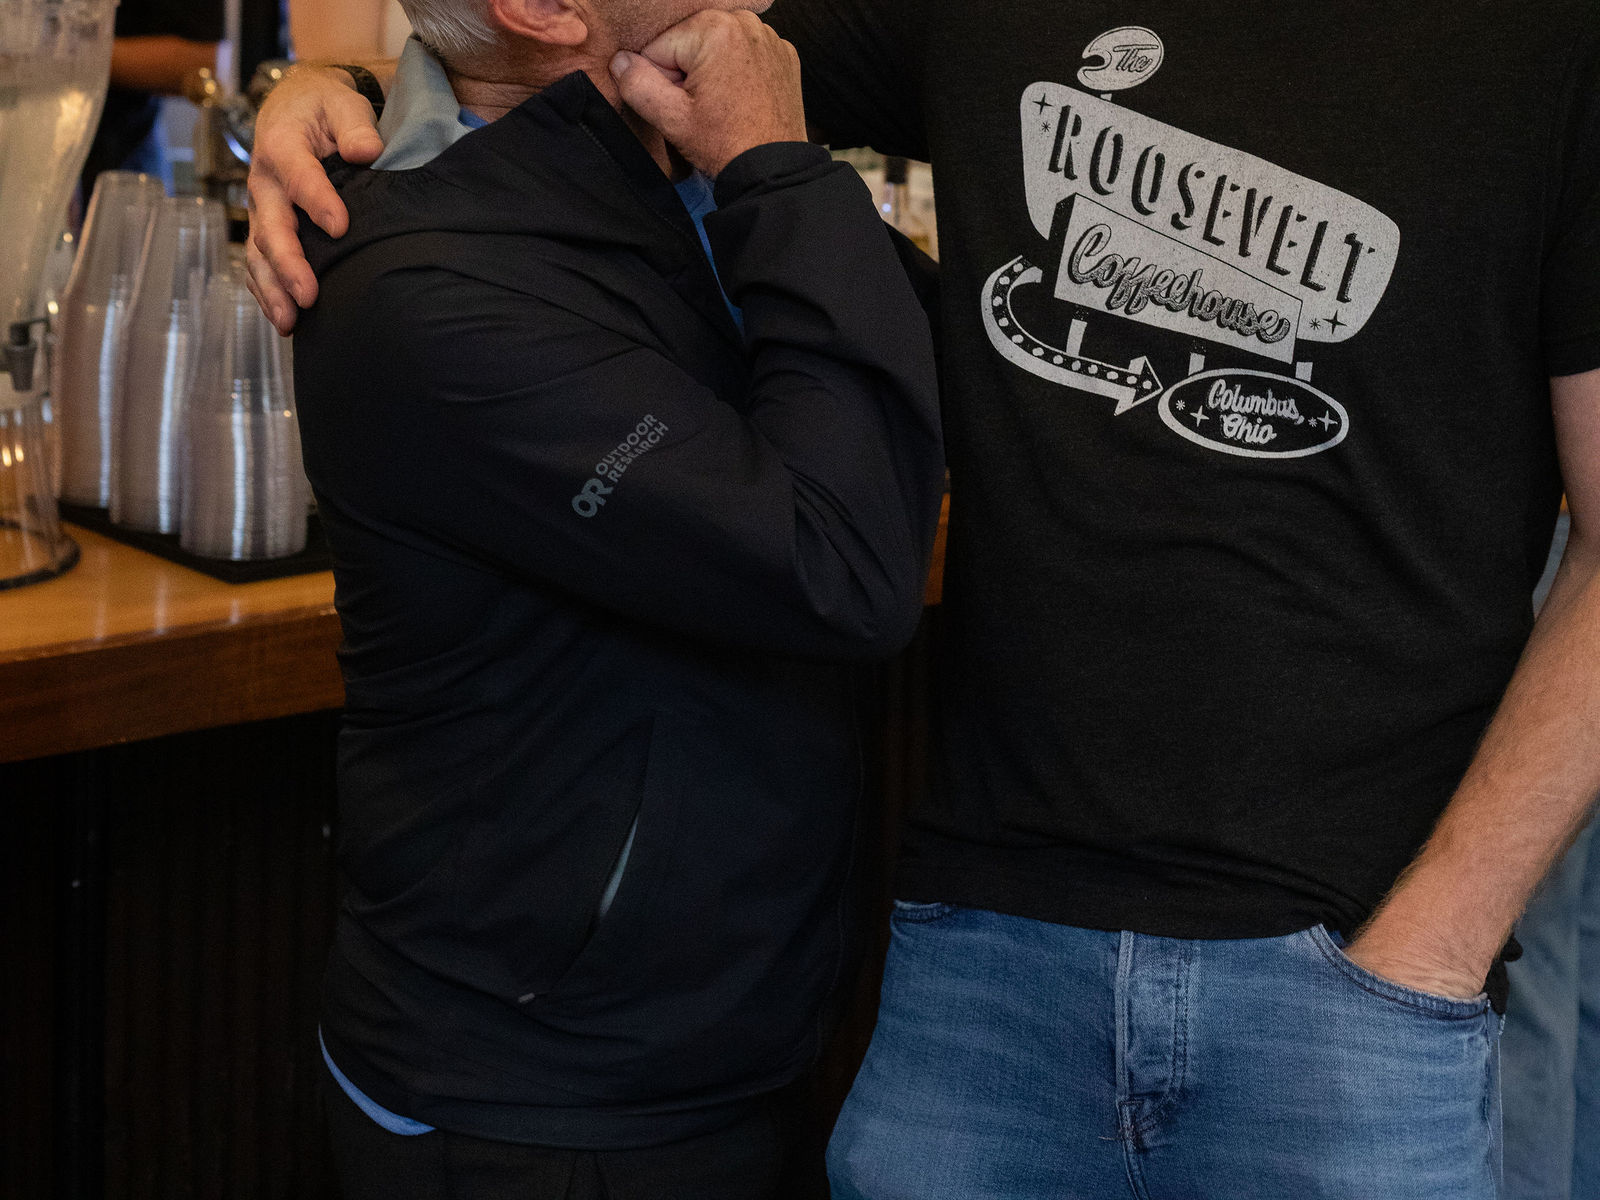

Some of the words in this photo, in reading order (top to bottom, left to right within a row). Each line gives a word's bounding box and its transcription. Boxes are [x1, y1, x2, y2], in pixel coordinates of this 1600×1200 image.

[1113, 42, 1159, 73] The
[1048, 104, 1376, 302] ROOSEVELT
[1067, 223, 1291, 344] Coffeehouse
[1208, 378, 1304, 425] Columbus,
[595, 414, 658, 475] OUTDOOR
[607, 421, 670, 482] RESEARCH
[1221, 413, 1277, 446] Ohio
[571, 478, 614, 518] OR
